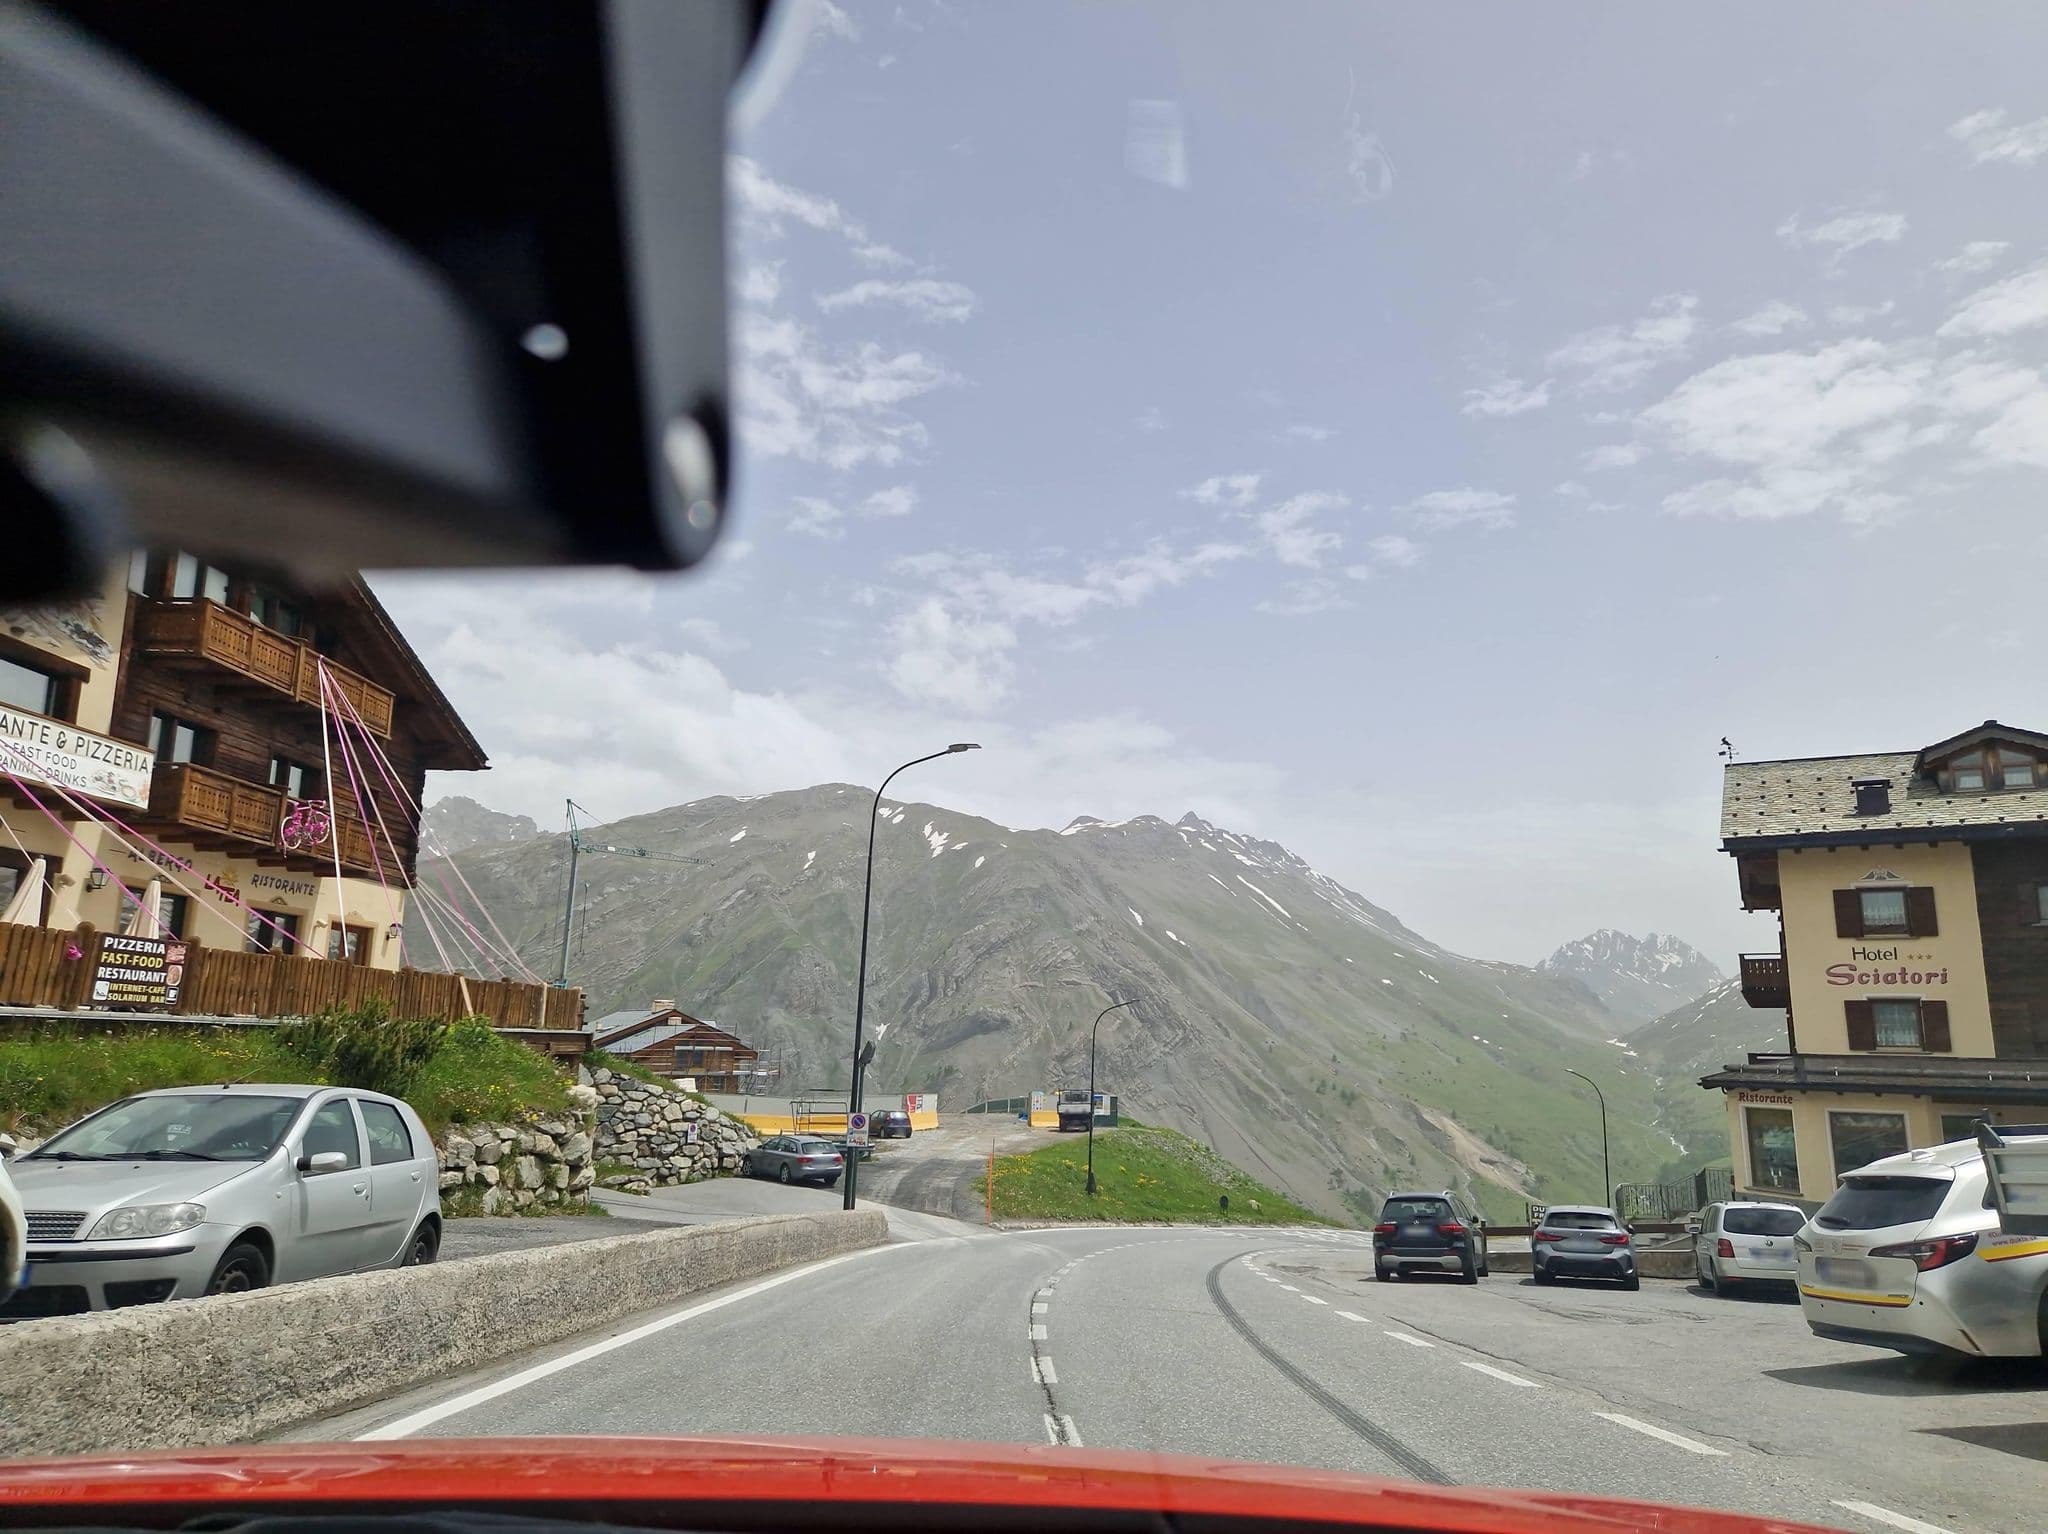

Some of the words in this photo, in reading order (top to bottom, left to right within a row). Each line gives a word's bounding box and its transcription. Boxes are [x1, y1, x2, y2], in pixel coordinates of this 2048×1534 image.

[13, 743, 42, 760] FAST
[46, 752, 77, 770] FOOD
[56, 731, 67, 749] &
[75, 736, 149, 773] PIZZERIA
[45, 768, 87, 788] DRINKS
[128, 846, 192, 872] ALBERGO
[251, 874, 316, 896] RISTORANTE
[104, 937, 166, 955] PIZZERIA
[1852, 947, 1898, 961] Hotel
[100, 952, 164, 969] FAST-FOOD
[97, 967, 168, 983] RESTAURANT
[1825, 963, 1949, 986] Sciatori
[107, 993, 148, 1002] SOLARIUM
[150, 996, 166, 1004] BAR
[1738, 1092, 1793, 1104] Ristorante
